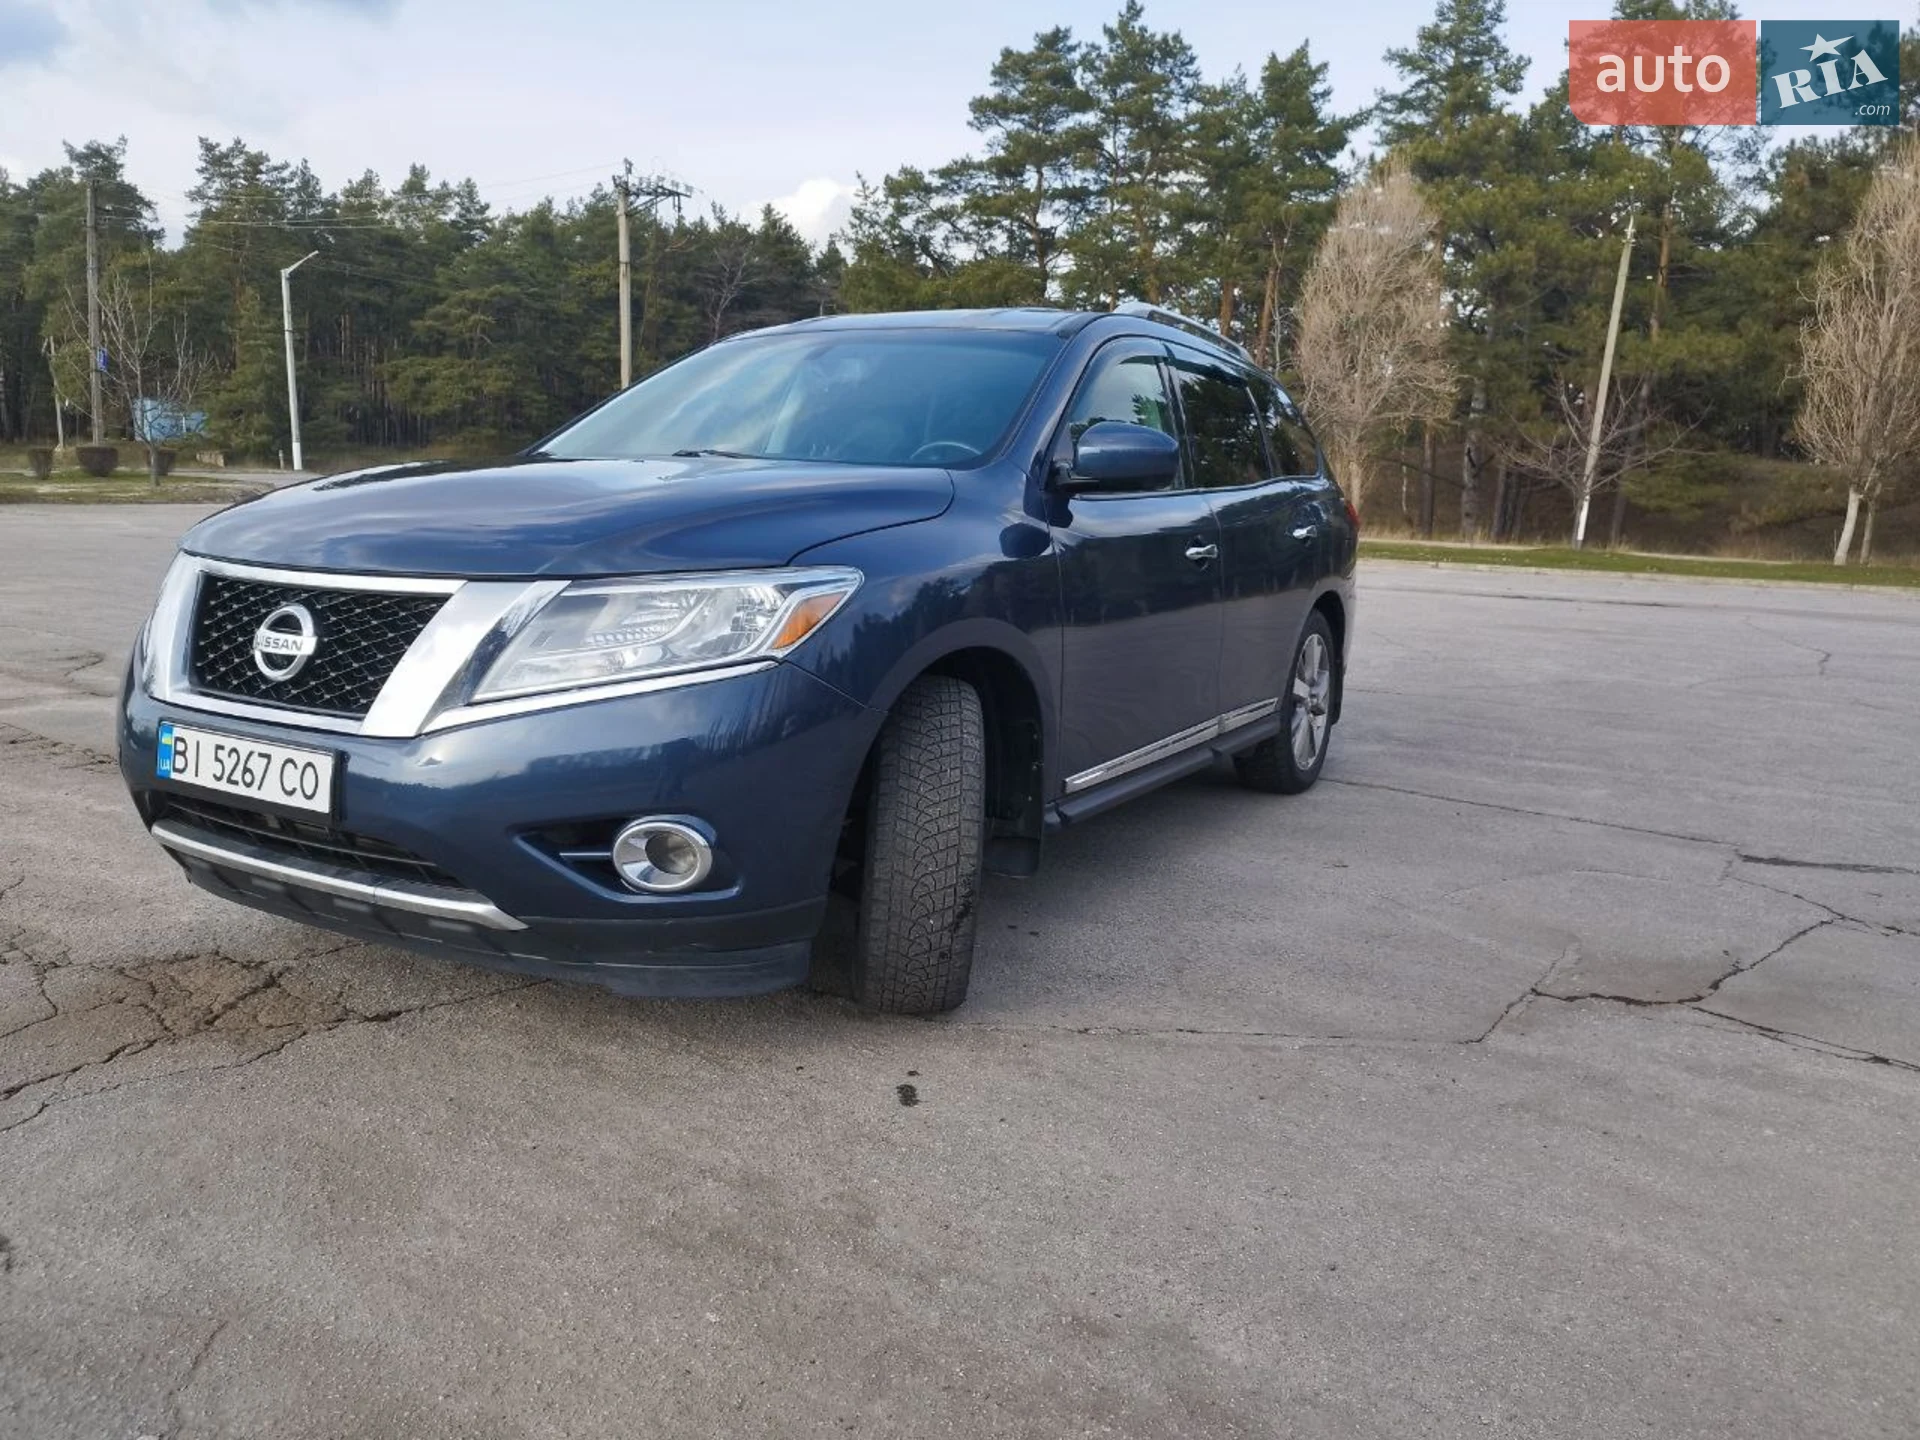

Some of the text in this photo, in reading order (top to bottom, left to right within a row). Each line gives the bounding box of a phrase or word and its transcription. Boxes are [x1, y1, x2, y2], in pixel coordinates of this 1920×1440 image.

[255, 635, 303, 652] NISSAN
[173, 736, 319, 800] BI 5267 CO
